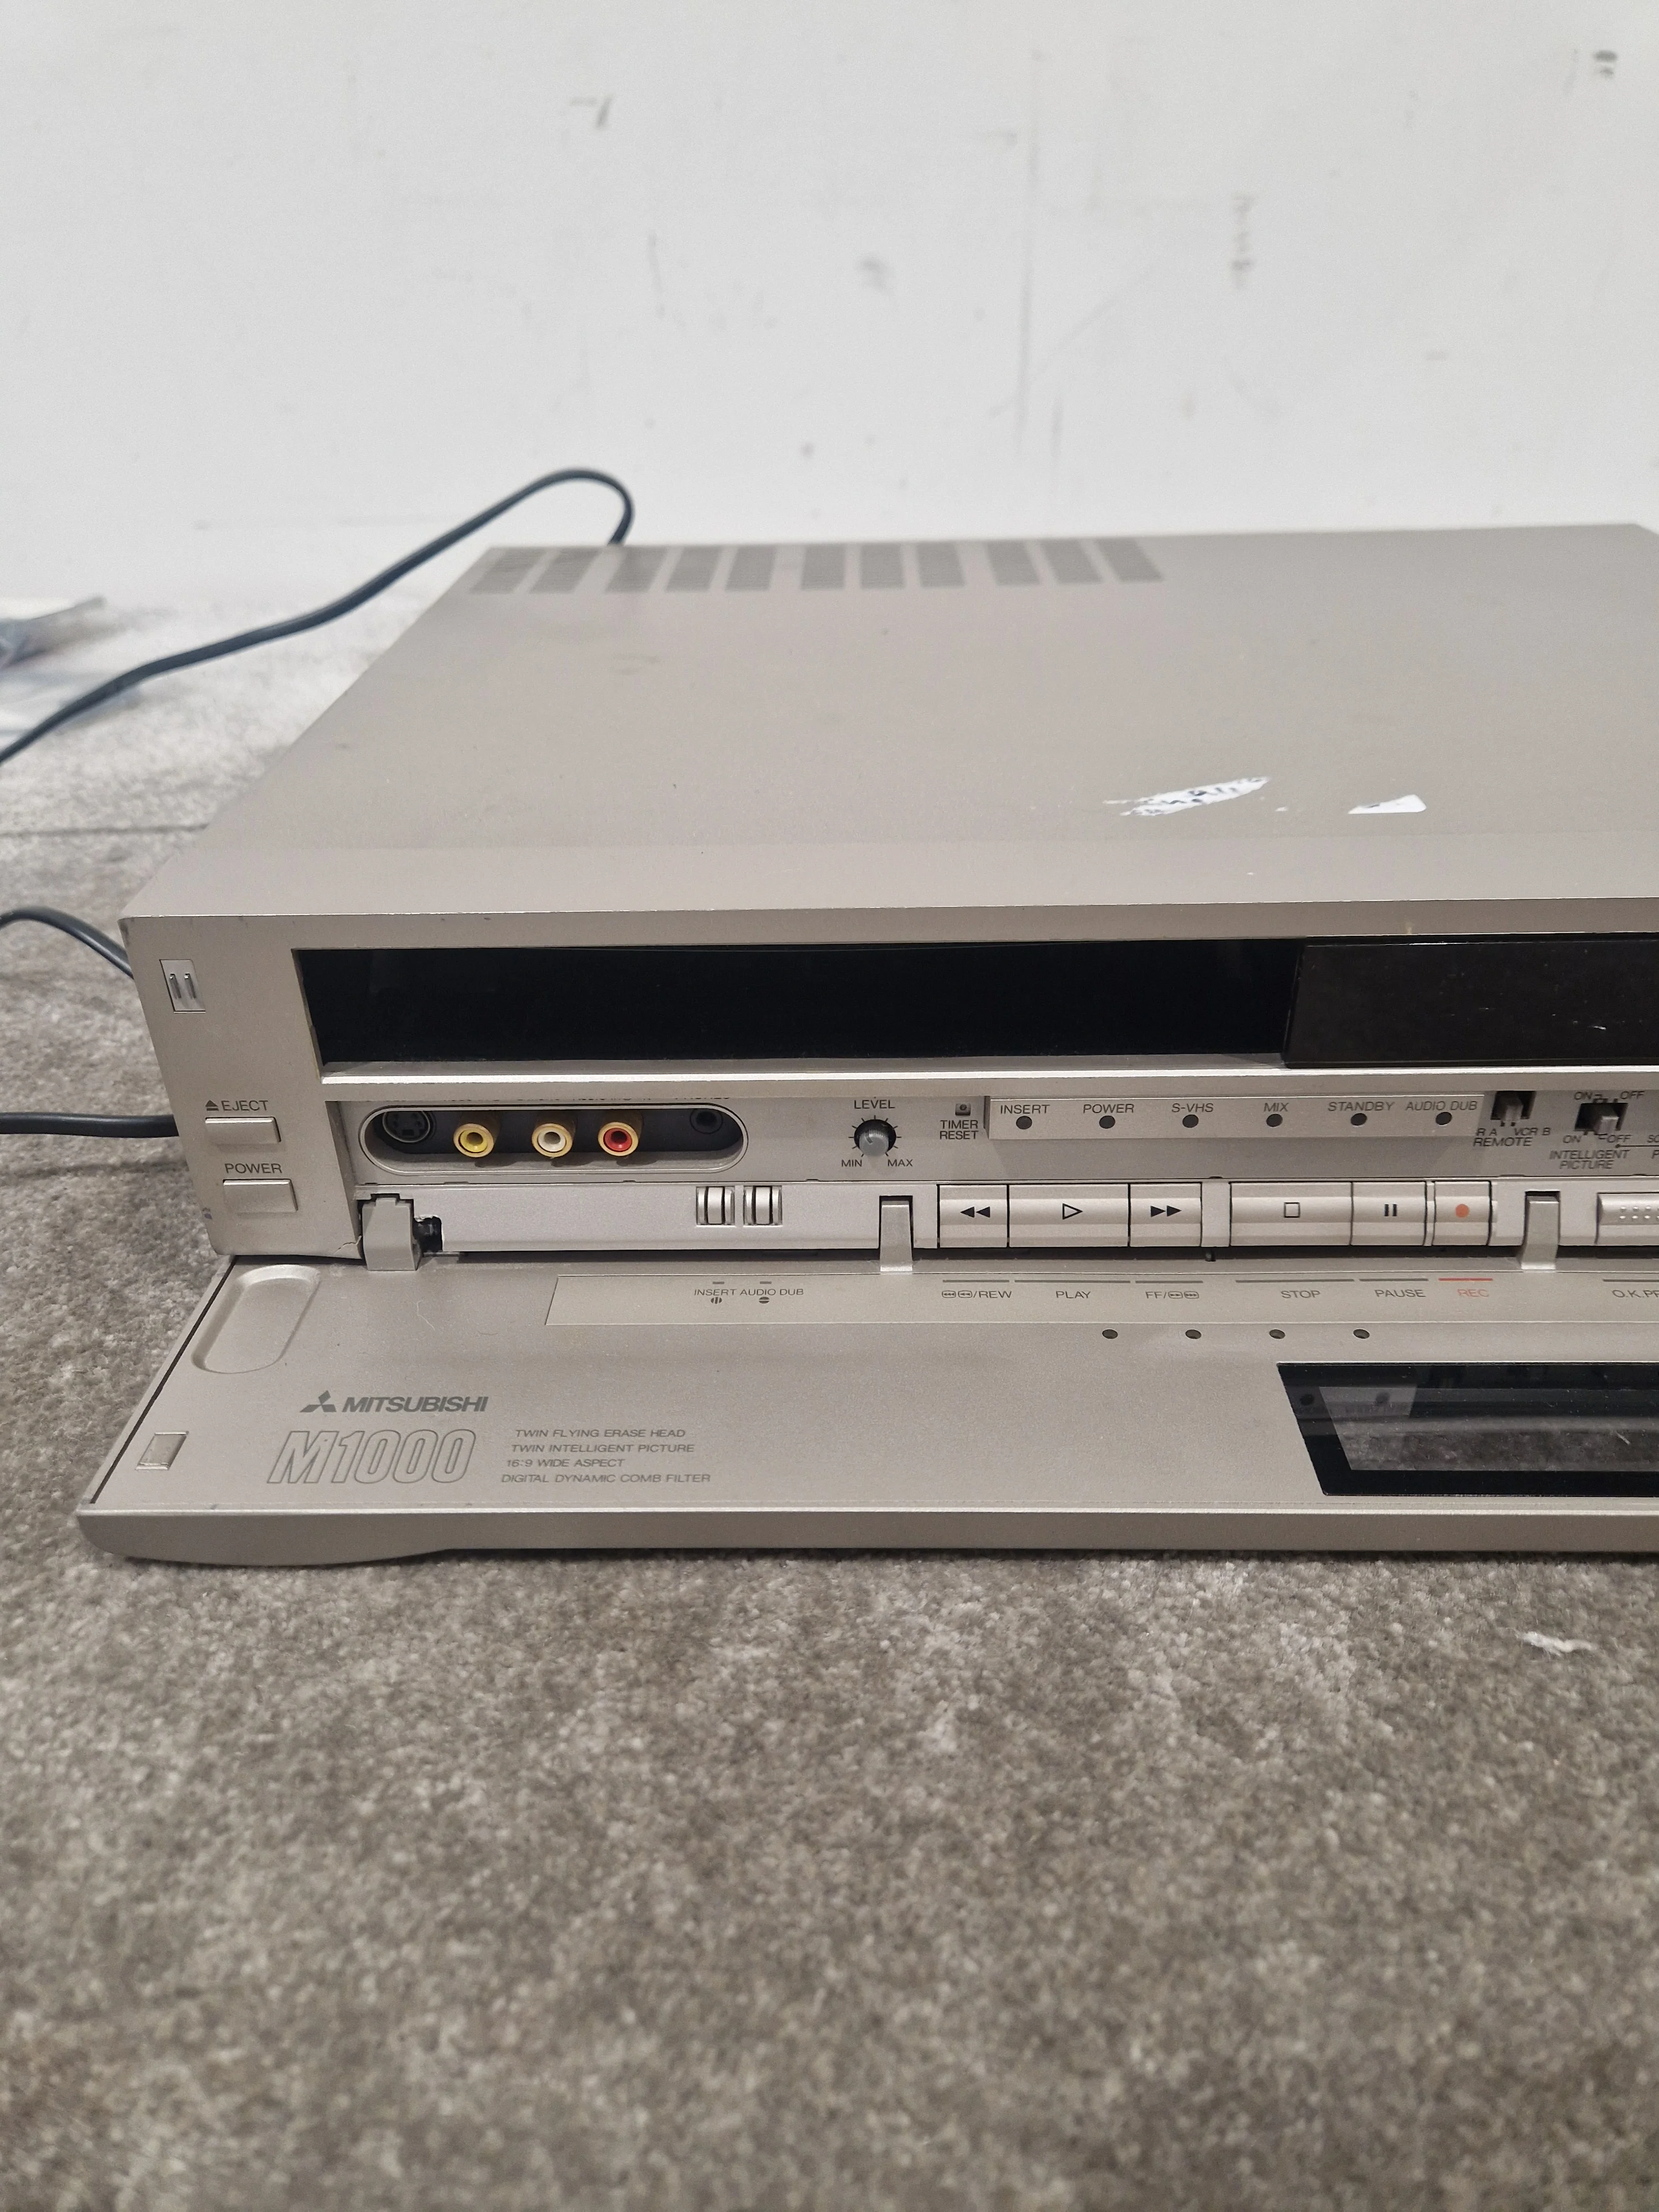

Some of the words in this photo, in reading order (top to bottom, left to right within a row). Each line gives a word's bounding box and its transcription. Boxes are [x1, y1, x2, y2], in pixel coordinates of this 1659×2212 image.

[1574, 1091, 1593, 1100] ON
[1620, 1091, 1645, 1100] OFF
[221, 1100, 268, 1112] EJECT
[854, 1099, 895, 1109] LEVEL
[1000, 1104, 1050, 1114] INSERT
[1083, 1103, 1134, 1114] POWER
[1171, 1103, 1214, 1113] S-VHS
[1264, 1102, 1289, 1112] MIX
[1328, 1101, 1394, 1112] STANDBY
[1405, 1100, 1446, 1111] AUDIO
[1450, 1100, 1478, 1110] DUB
[940, 1119, 978, 1129] TIMER
[940, 1130, 979, 1140] RESET
[1514, 1127, 1538, 1136] VCR
[1542, 1127, 1551, 1136] B
[1473, 1136, 1532, 1147] REMOTE
[1563, 1135, 1582, 1144] ON
[1605, 1134, 1632, 1143] OFF
[1550, 1149, 1631, 1160] INTELLIGENT
[841, 1159, 862, 1167] MIN
[888, 1159, 913, 1167] MAX
[1559, 1160, 1614, 1170] PICTURE
[224, 1163, 283, 1174] POWER
[1056, 1291, 1091, 1299] PLAY
[1281, 1290, 1321, 1299] STOP
[1374, 1289, 1426, 1297] PAUSE
[1457, 1288, 1489, 1297] REC
[342, 1396, 489, 1413] MITSUBISHI
[552, 1429, 599, 1438] FLYING
[604, 1429, 646, 1438] ERASE
[650, 1429, 686, 1437] HEAD
[512, 1444, 545, 1453] TWIN
[549, 1444, 634, 1453] INTELLIGENT
[638, 1444, 695, 1453] PICTURE
[266, 1428, 477, 1484] M1000
[507, 1459, 533, 1467] 16:9
[538, 1459, 570, 1467] WIDE
[573, 1458, 625, 1468] ASPECT
[501, 1474, 549, 1483] DIGITAL
[555, 1474, 615, 1483] DYNAMIC
[620, 1474, 662, 1483] COMB
[666, 1474, 711, 1483] FILTER
